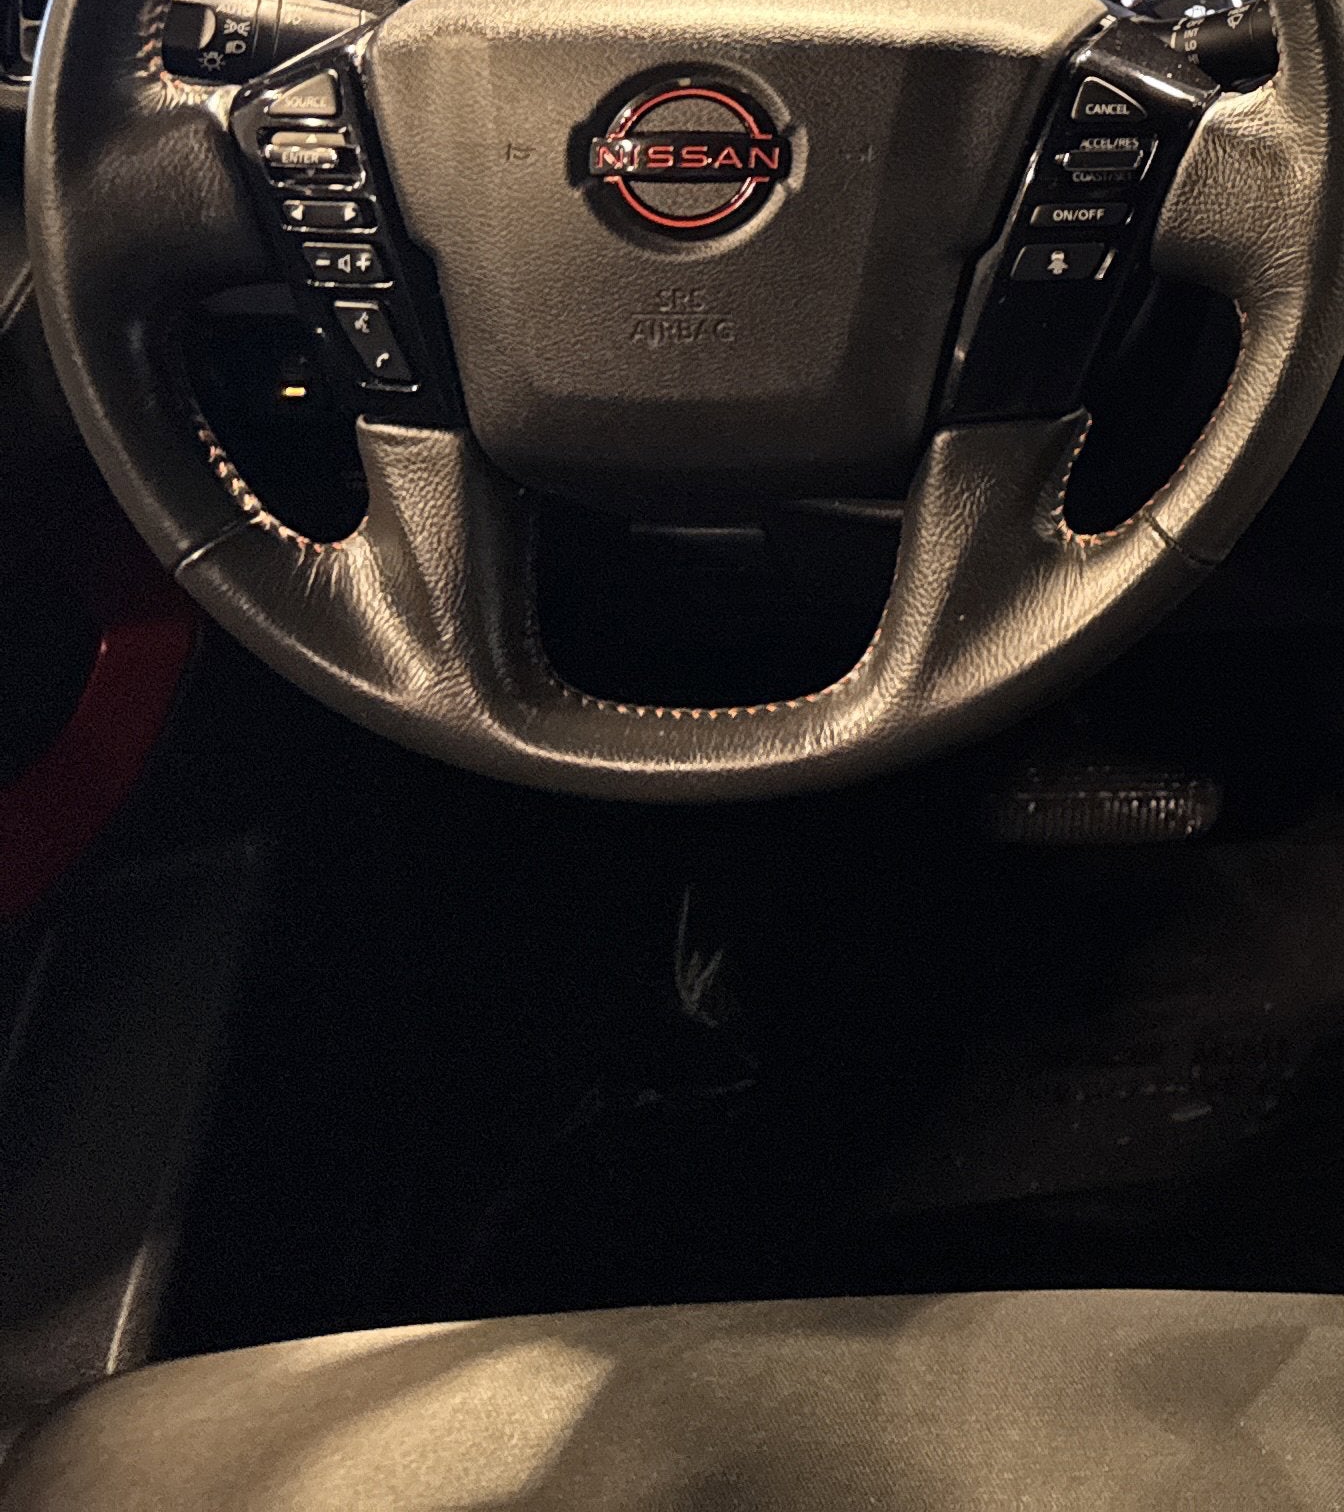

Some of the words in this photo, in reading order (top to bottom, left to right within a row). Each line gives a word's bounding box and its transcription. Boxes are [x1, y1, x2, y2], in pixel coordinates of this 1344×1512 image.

[1184, 28, 1199, 39] INT
[1184, 40, 1198, 51] LO
[284, 96, 327, 107] SOURCE
[1085, 103, 1130, 116] CANCEL
[1079, 138, 1140, 149] ACCEL/RES
[281, 151, 320, 164] ENTER
[597, 145, 779, 170] NISSAN
[1052, 209, 1105, 222] ON/OFF
[655, 289, 705, 313] SRS
[630, 319, 737, 345] AIRBAG
